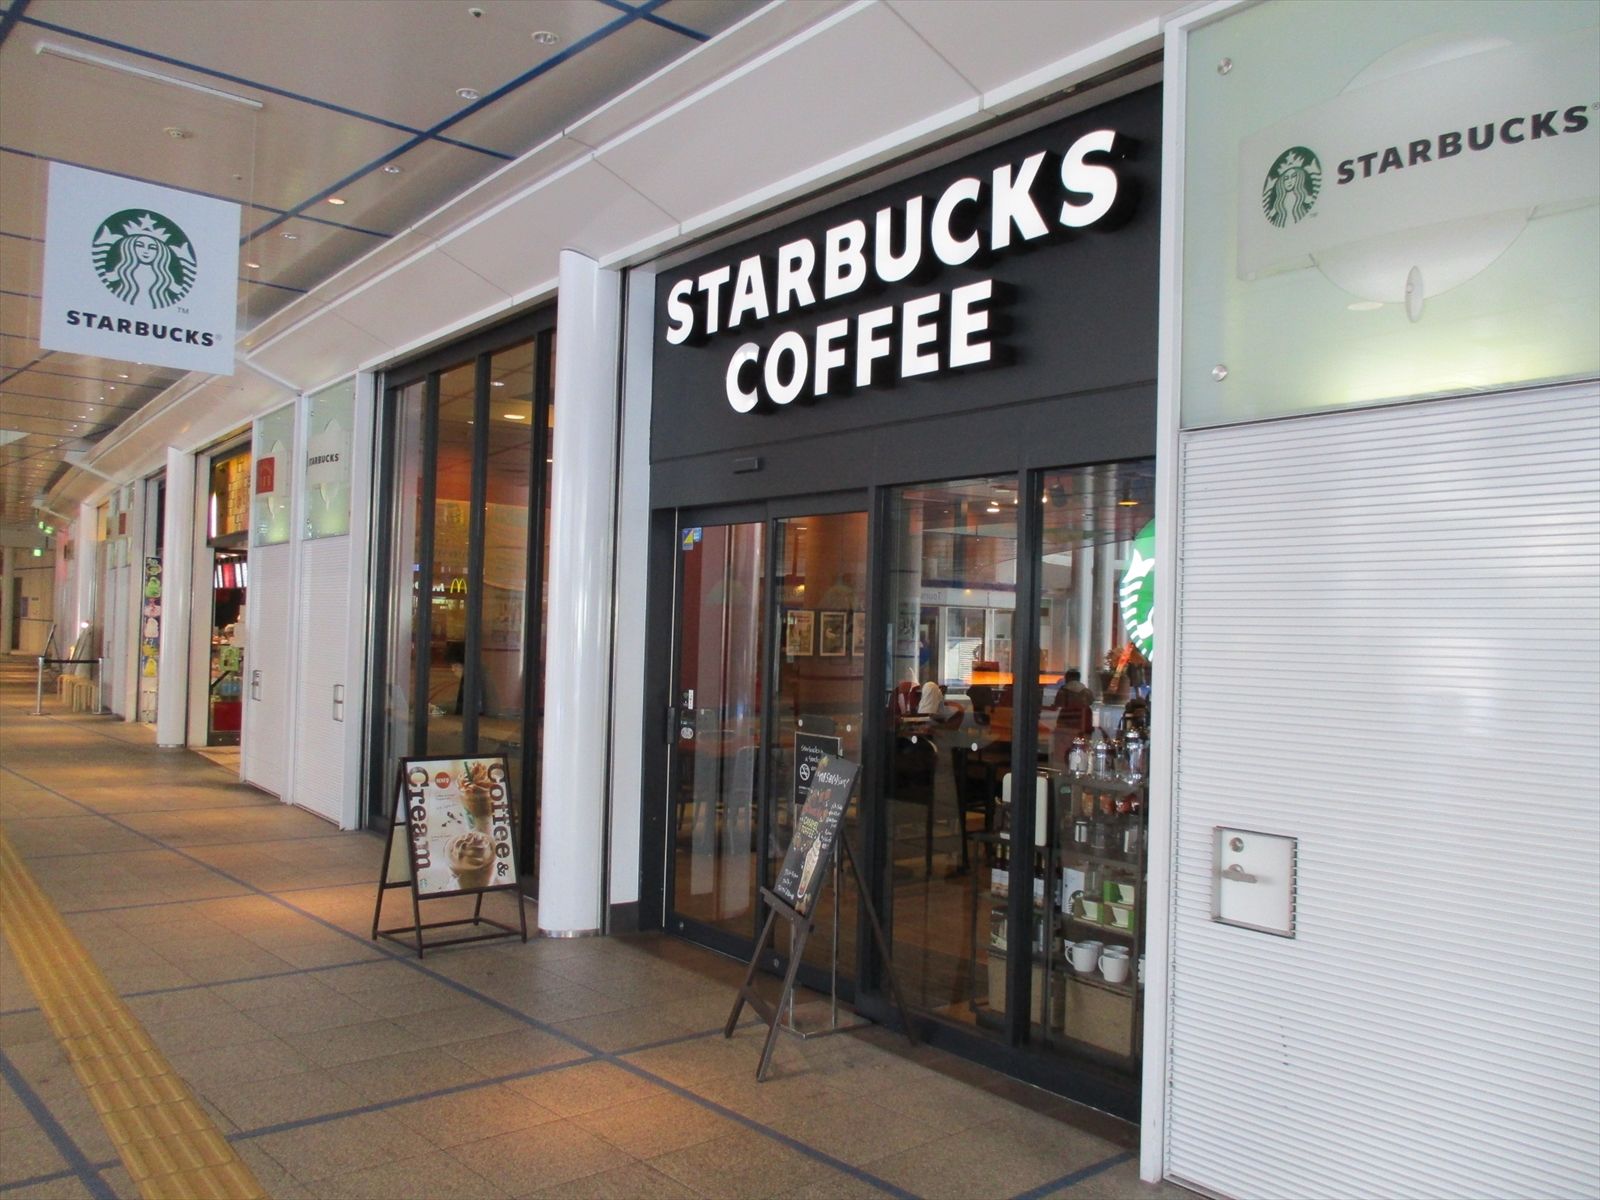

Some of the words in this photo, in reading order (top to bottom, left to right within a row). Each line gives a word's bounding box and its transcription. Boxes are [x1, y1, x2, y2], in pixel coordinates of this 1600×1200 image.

[1337, 106, 1589, 185] STARBUCKS
[666, 130, 1119, 345] STARBUCKS
[66, 310, 214, 347] STARBUCKS
[726, 279, 993, 414] COFFEE
[408, 766, 431, 870] Cream
[487, 763, 511, 859] Coffee
